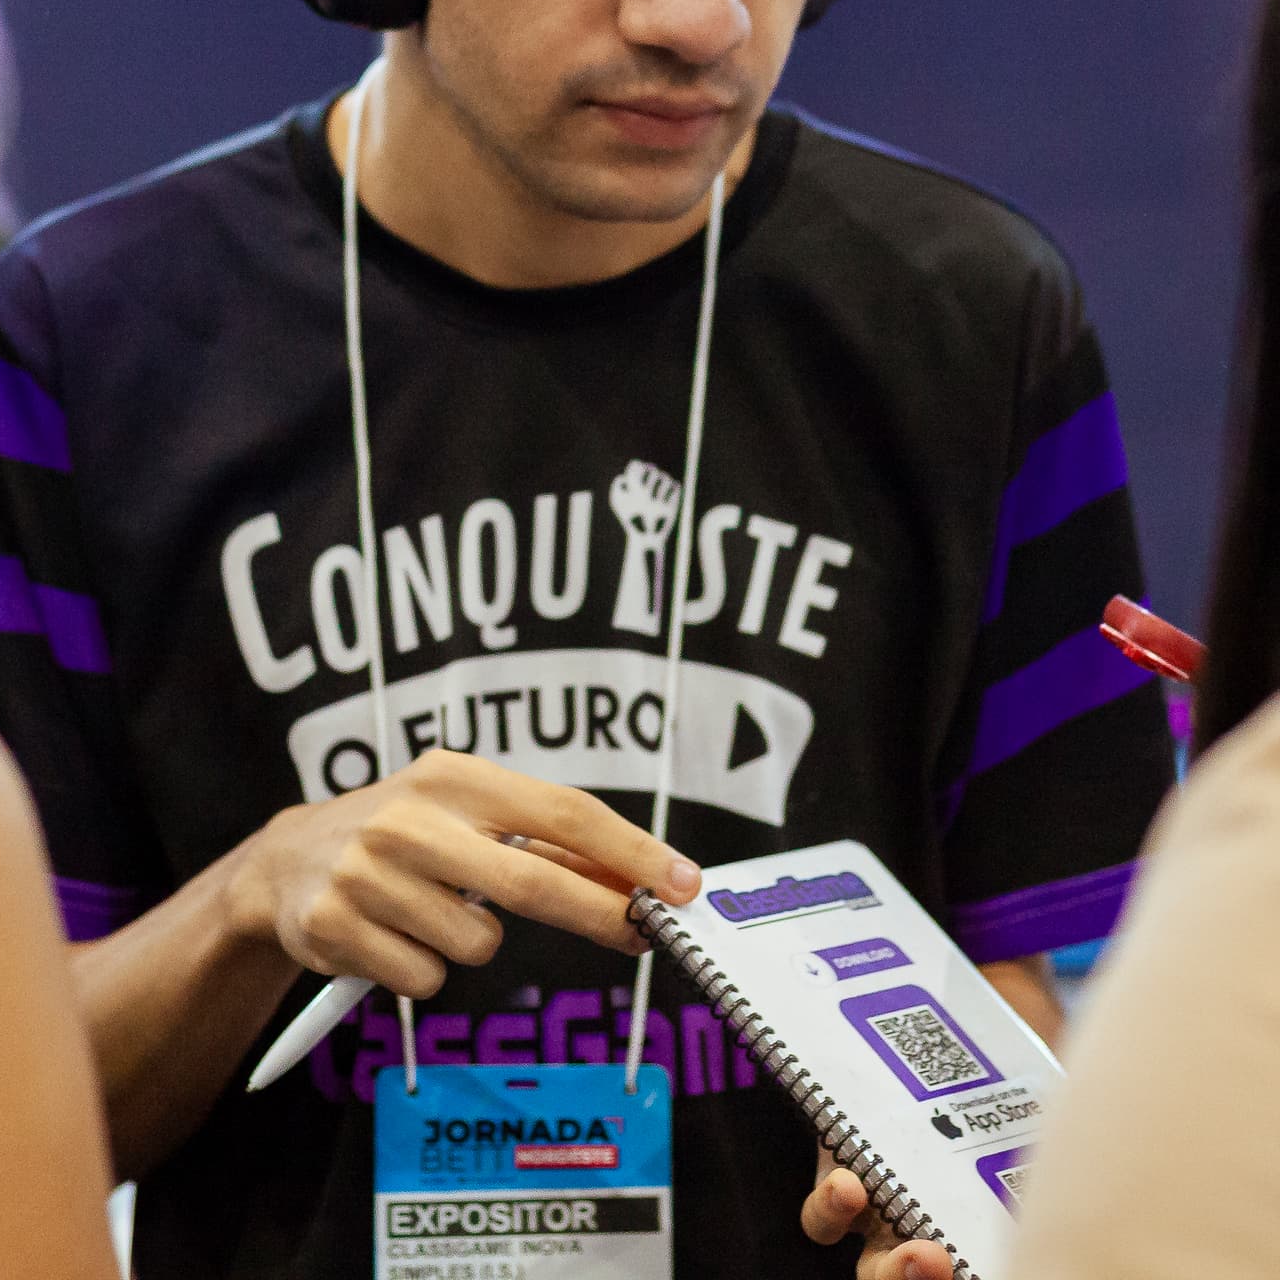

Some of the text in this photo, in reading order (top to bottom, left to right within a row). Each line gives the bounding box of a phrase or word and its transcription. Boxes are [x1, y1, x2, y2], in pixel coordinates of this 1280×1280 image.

[322, 685, 666, 797] O FUTURO
[948, 1092, 999, 1113] Download
[963, 1100, 1043, 1134] App Store
[424, 1117, 610, 1144] JORNADA
[422, 1144, 507, 1173] BETT
[390, 1200, 599, 1235] EXPOSITOR
[386, 1240, 512, 1258] CLASSGAME
